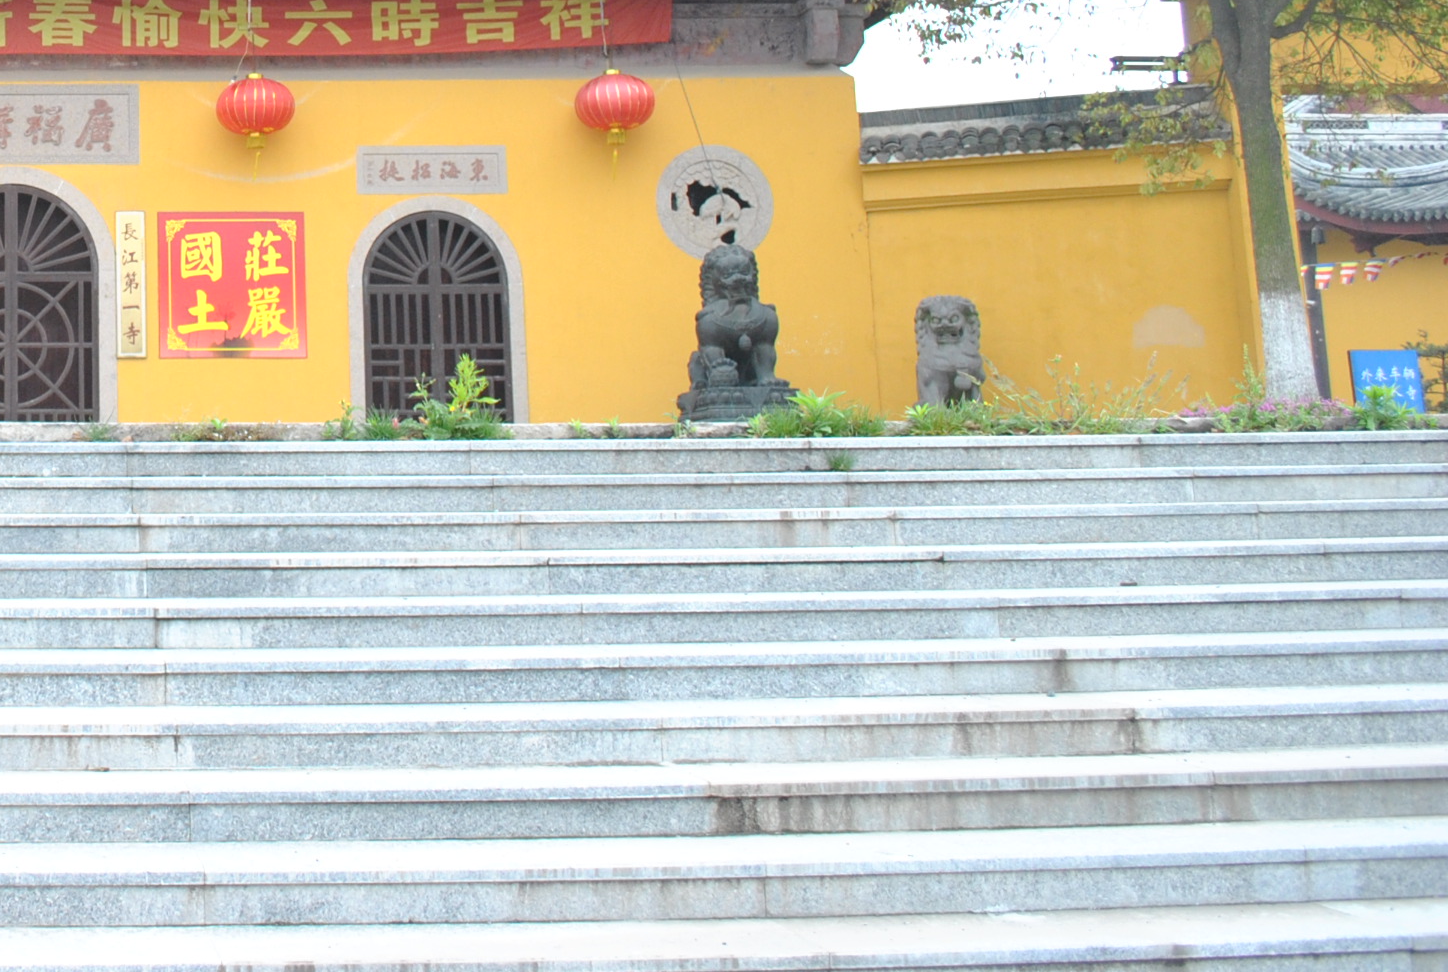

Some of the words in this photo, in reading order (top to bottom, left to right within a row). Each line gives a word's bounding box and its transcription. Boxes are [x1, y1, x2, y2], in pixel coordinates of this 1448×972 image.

[121, 222, 141, 346] 長江第一寺
